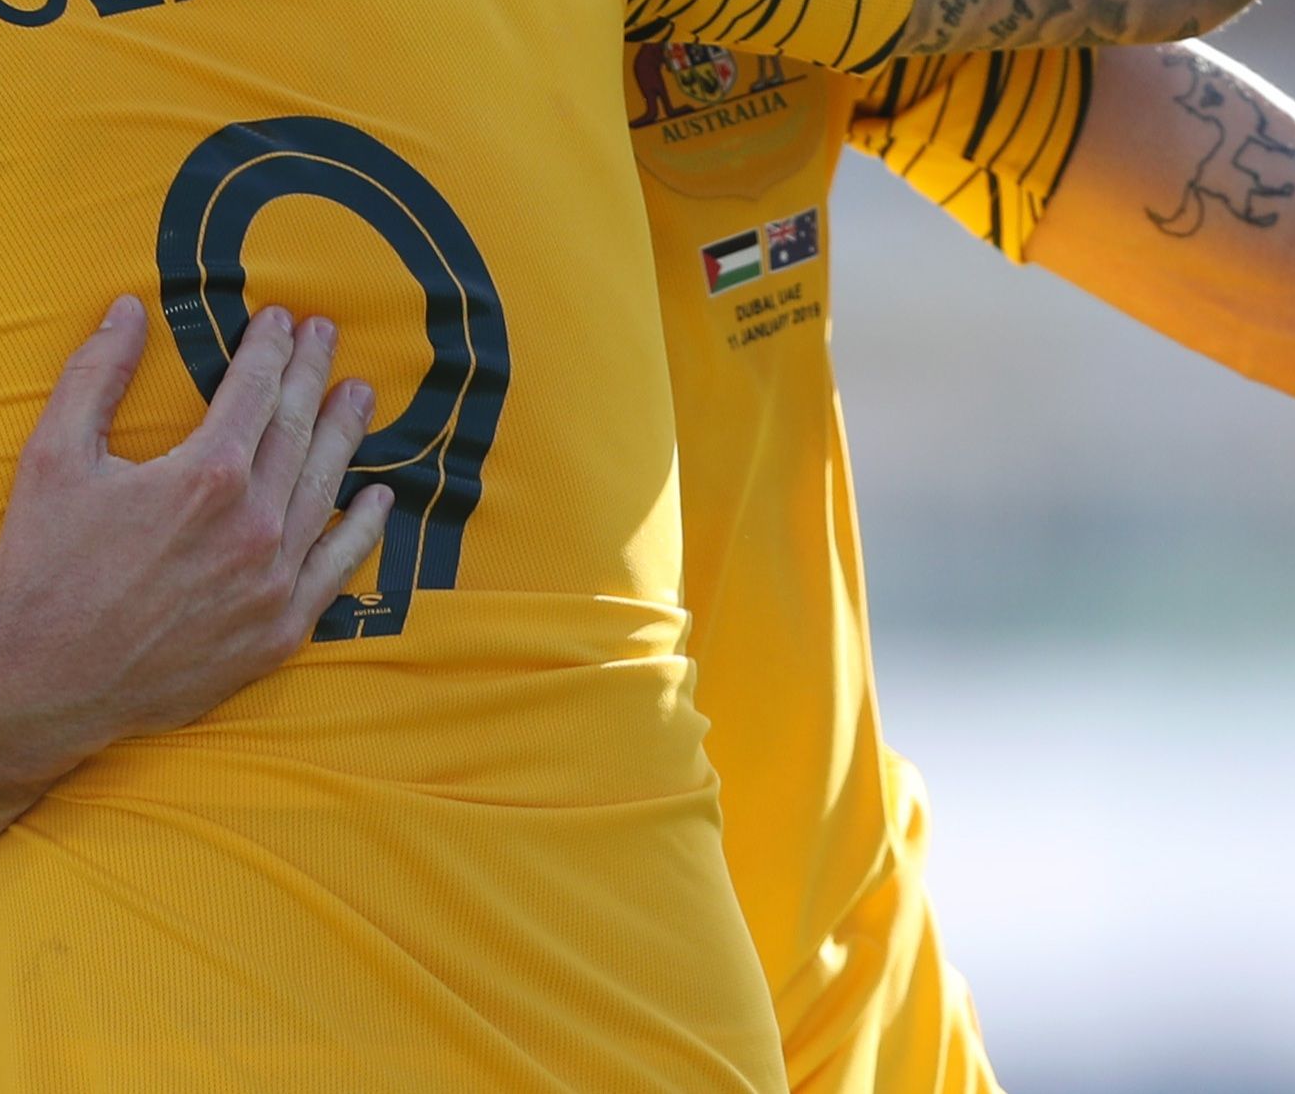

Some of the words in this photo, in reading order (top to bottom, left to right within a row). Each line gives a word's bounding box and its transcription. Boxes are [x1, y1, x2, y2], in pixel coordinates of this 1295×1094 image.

[661, 91, 789, 145] AUSTRALIA
[741, 312, 790, 346] JANUARY
[155, 114, 512, 642] 9
[353, 606, 392, 617] AUSTRALIA
